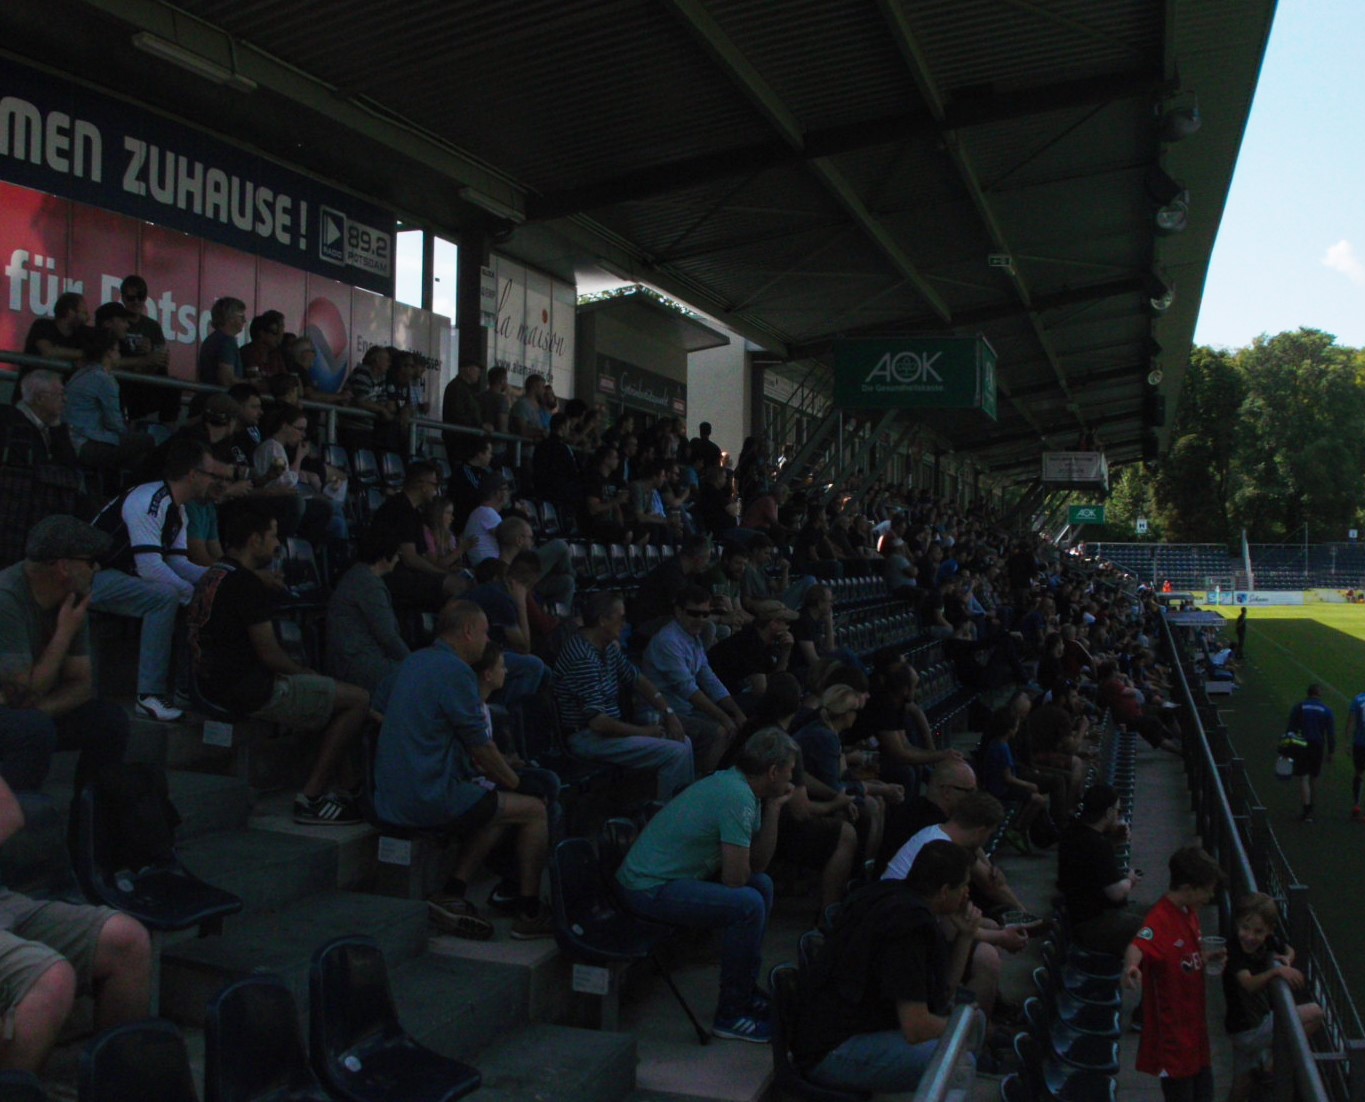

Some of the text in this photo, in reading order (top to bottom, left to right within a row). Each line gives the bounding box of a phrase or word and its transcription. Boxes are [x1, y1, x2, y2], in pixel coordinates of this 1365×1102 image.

[347, 226, 389, 258] 89.2
[347, 251, 390, 274] POTSDAM
[865, 351, 944, 383] AOK
[1076, 508, 1097, 517] AOK
